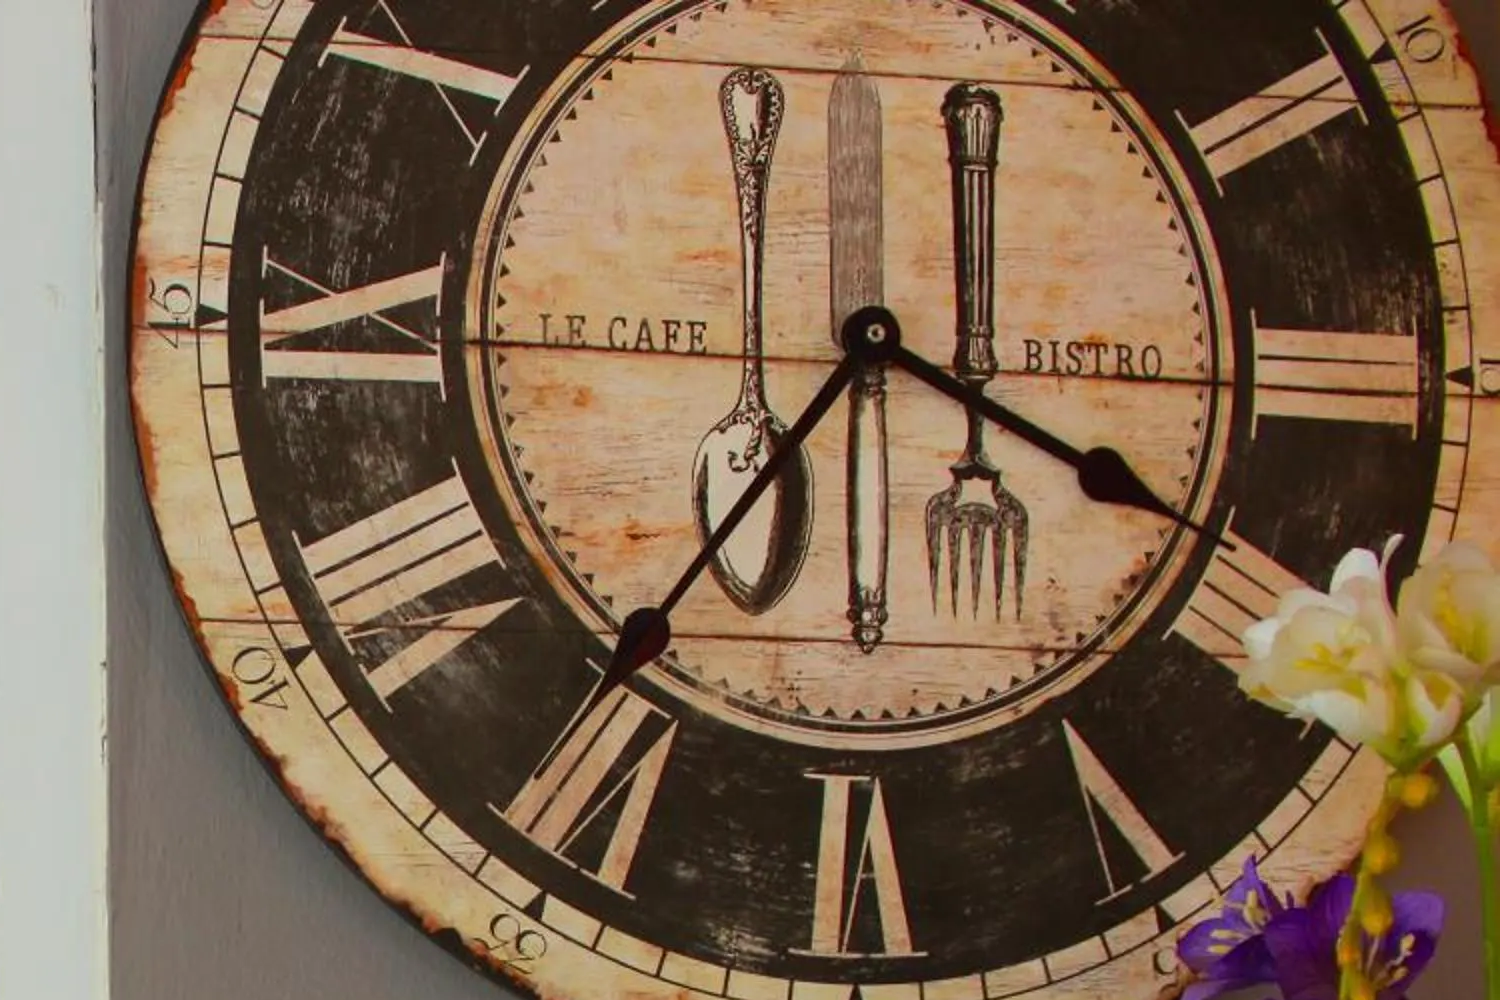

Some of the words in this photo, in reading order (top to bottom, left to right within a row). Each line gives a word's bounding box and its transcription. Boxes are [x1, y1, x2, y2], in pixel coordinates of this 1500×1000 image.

[1396, 15, 1445, 64] 10
[538, 313, 588, 347] LE
[608, 316, 708, 356] CAFE
[1022, 339, 1163, 379] BISTRO
